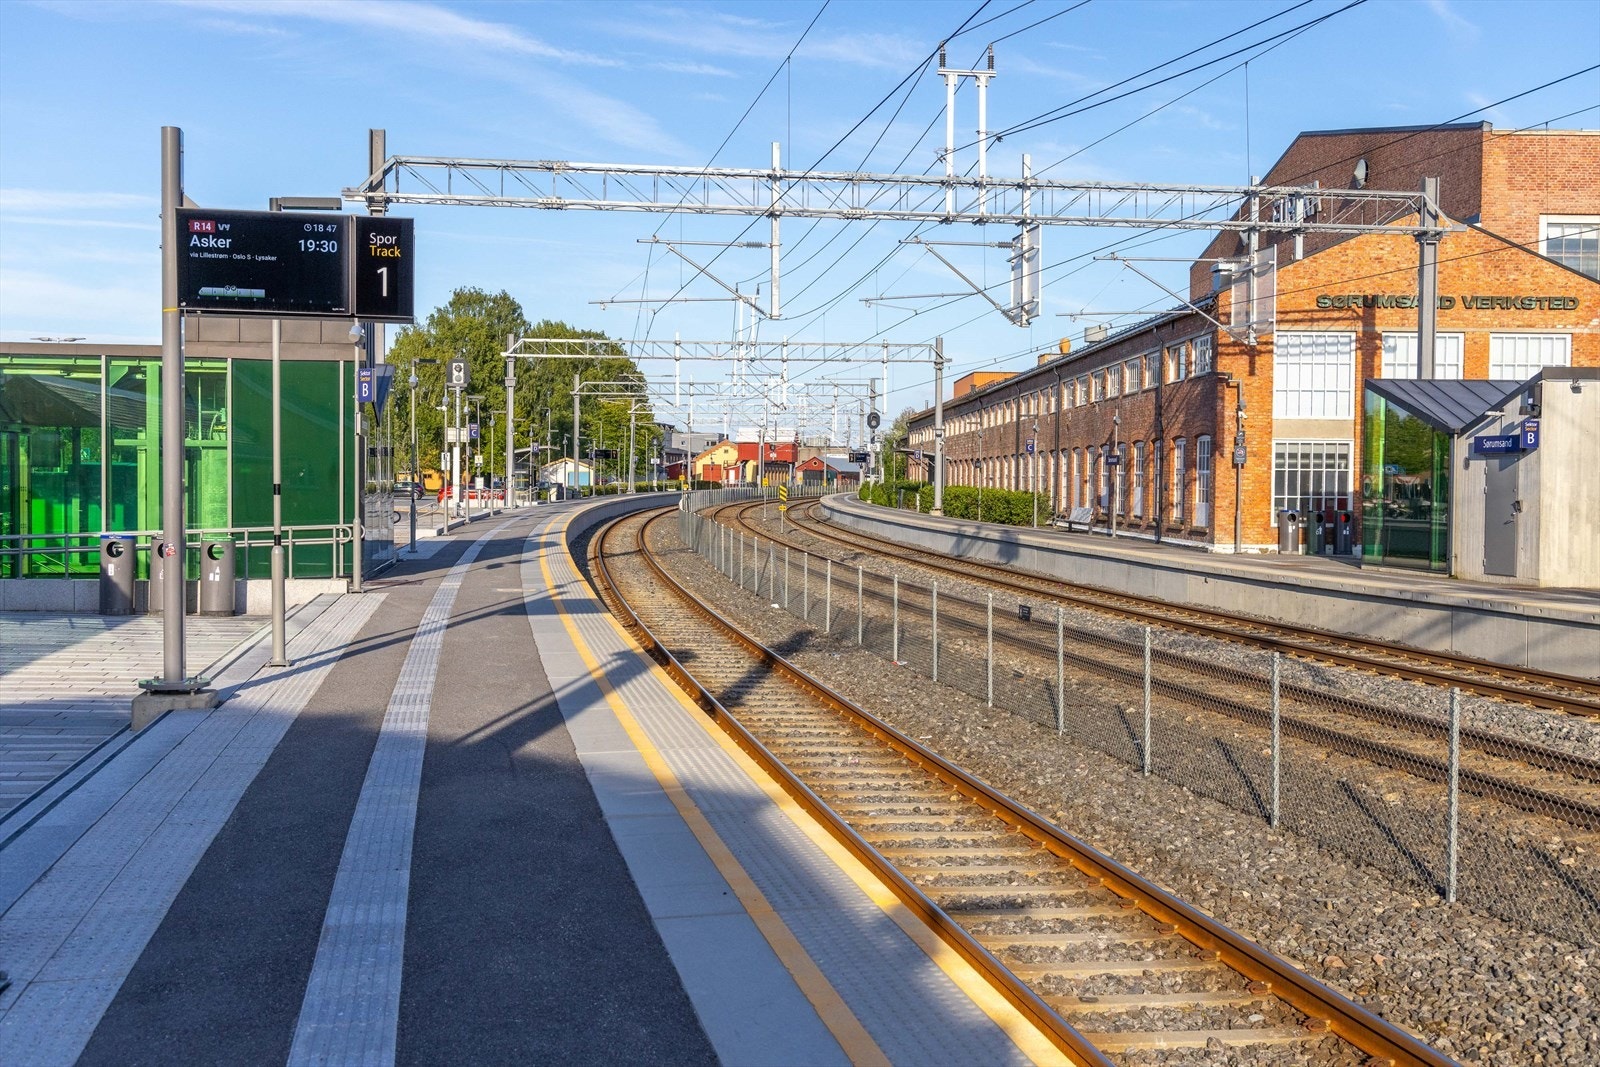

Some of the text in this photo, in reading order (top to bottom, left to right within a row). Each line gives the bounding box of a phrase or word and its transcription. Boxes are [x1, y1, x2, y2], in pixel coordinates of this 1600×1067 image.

[190, 234, 232, 248] Asker
[298, 239, 338, 253] 19:30
[369, 232, 397, 246] Spor
[369, 245, 401, 257] Track
[377, 267, 387, 297] 1
[1462, 295, 1579, 311] VERKSTED
[362, 383, 369, 397] B
[1483, 438, 1512, 448] Sørumsand
[1527, 432, 1535, 444] B
